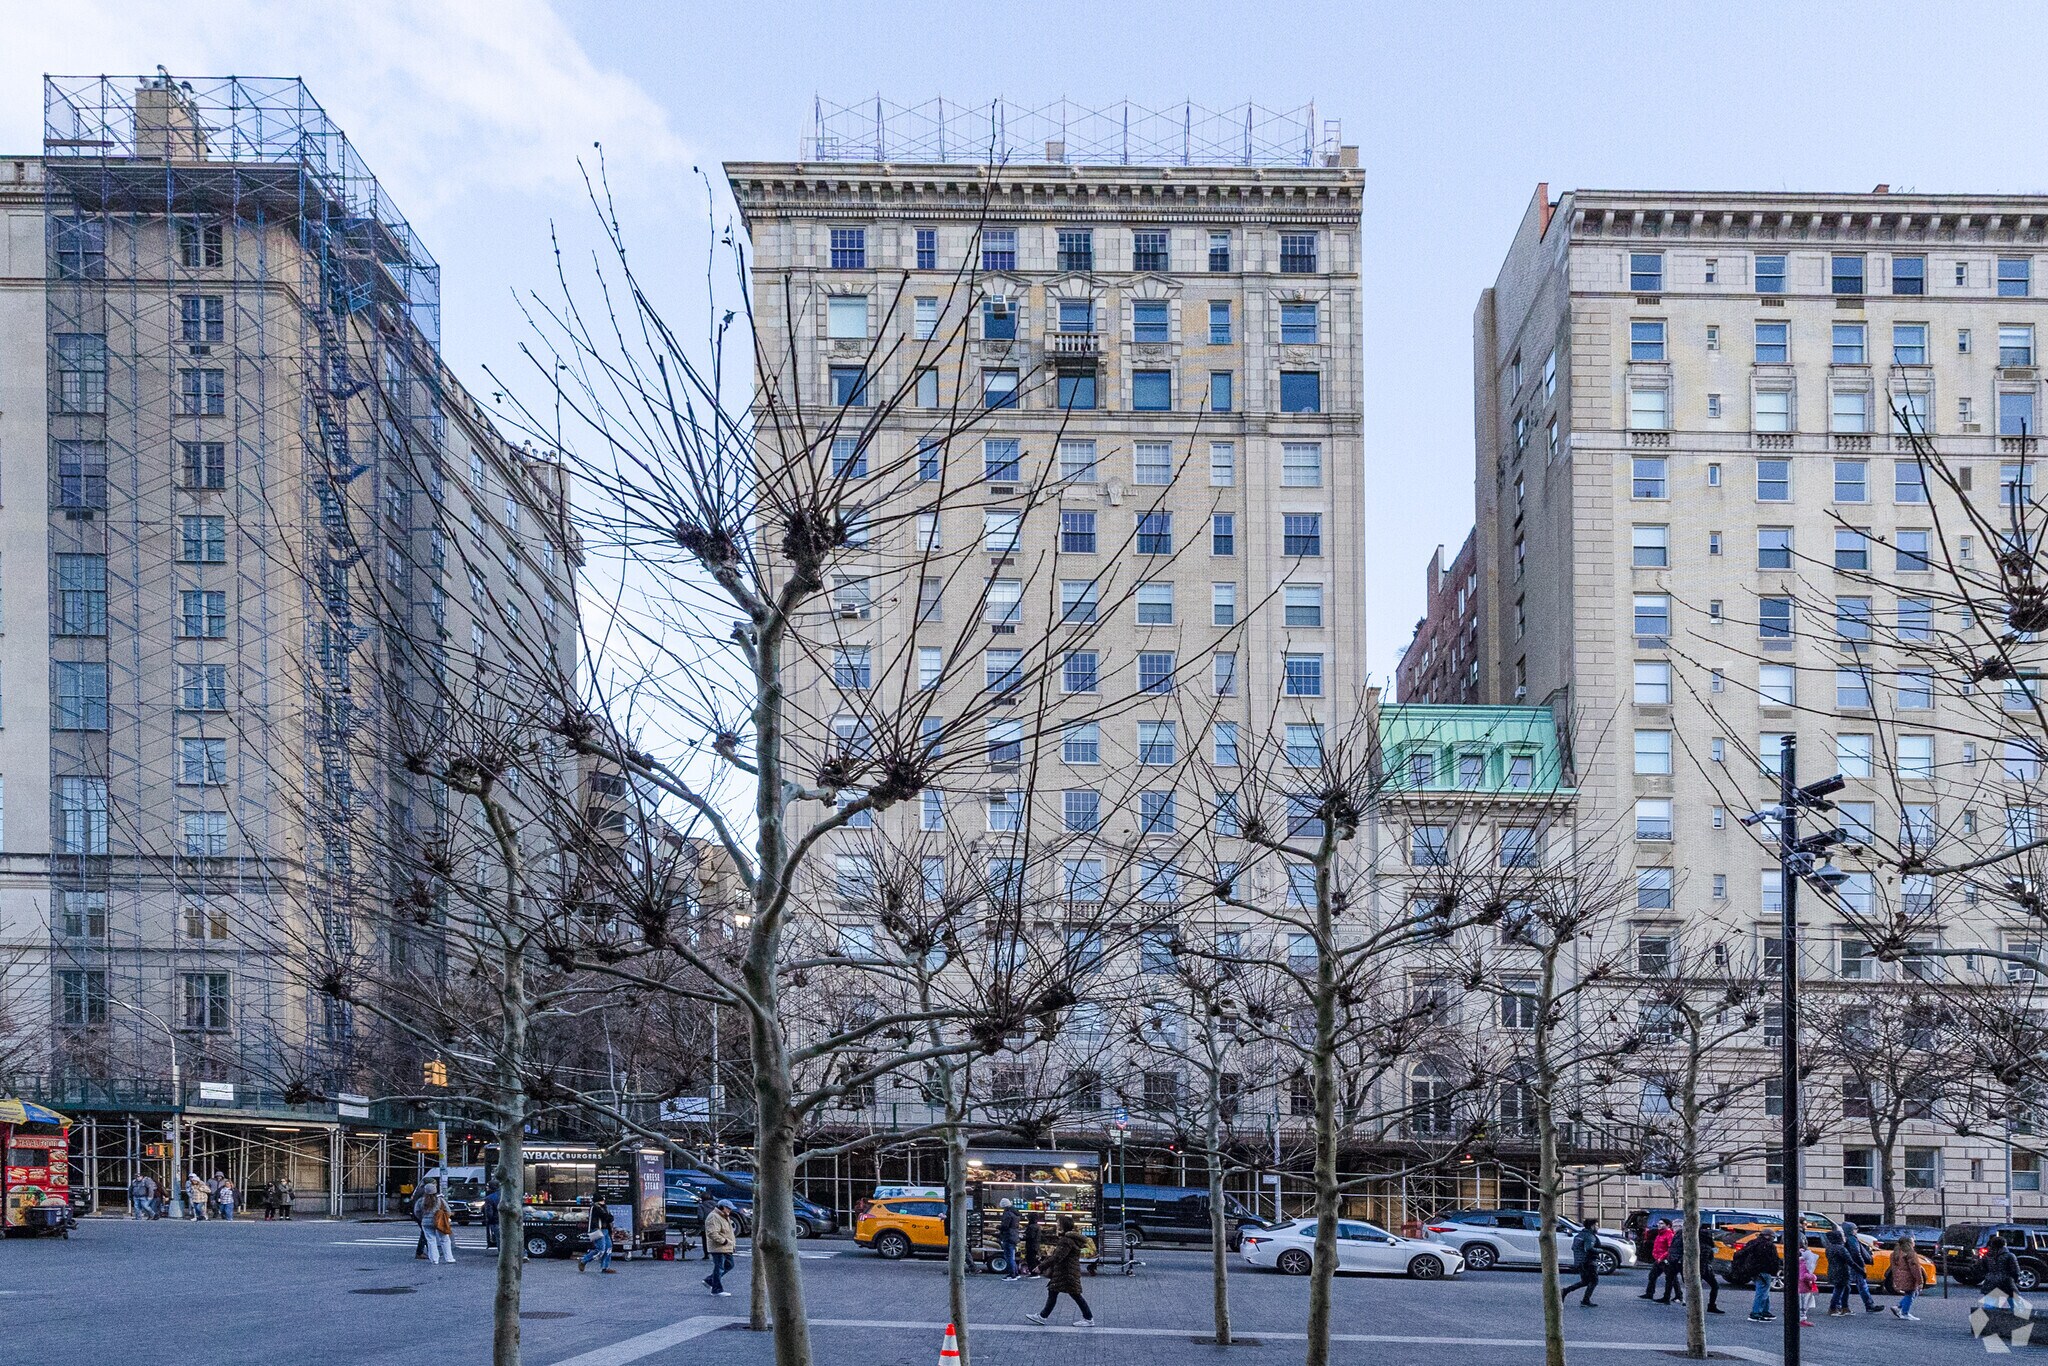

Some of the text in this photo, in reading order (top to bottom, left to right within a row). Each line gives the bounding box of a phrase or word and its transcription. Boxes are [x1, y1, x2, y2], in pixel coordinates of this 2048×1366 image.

[522, 1151, 565, 1160] AYBACK
[643, 1173, 660, 1182] CHEESE
[644, 1182, 659, 1190] STEAK
